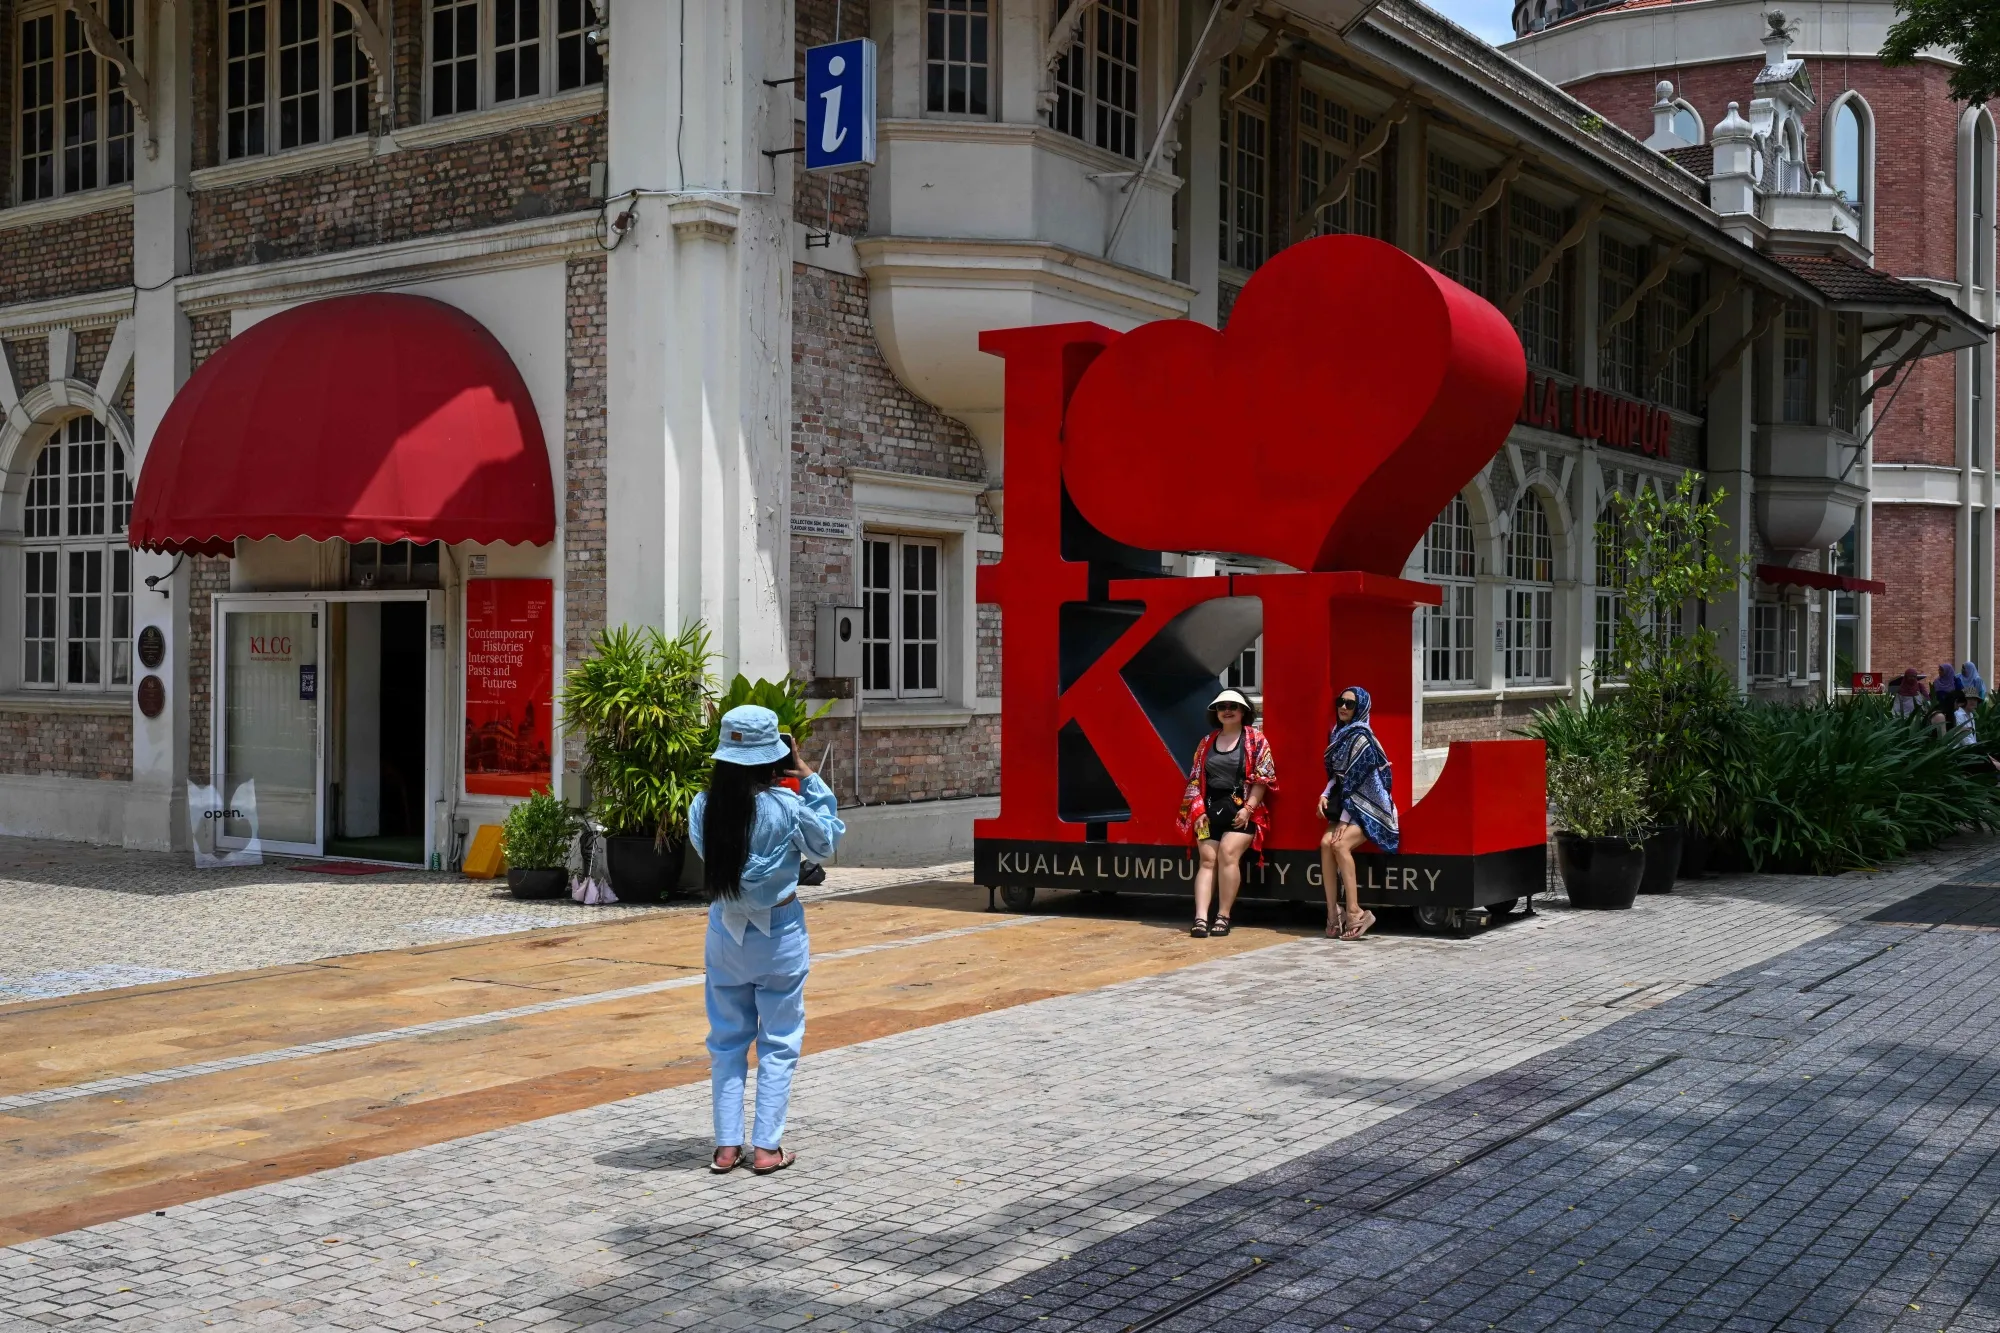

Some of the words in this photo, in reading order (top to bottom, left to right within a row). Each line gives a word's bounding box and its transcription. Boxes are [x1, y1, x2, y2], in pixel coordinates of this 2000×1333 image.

[1519, 372, 1560, 430] LA
[1573, 384, 1672, 458] LUMPUR
[468, 627, 534, 643] Contemporary
[250, 636, 292, 654] KLCG
[482, 640, 524, 652] Histories
[468, 652, 523, 667] Intersecting
[468, 664, 491, 676] Pasts
[493, 664, 510, 676] and
[482, 676, 517, 689] Futures
[204, 808, 244, 821] open.
[998, 852, 1085, 877] KUALA
[1097, 856, 1194, 881] LUMPU
[1246, 861, 1291, 885] ITY
[1306, 863, 1442, 892] GLERY
